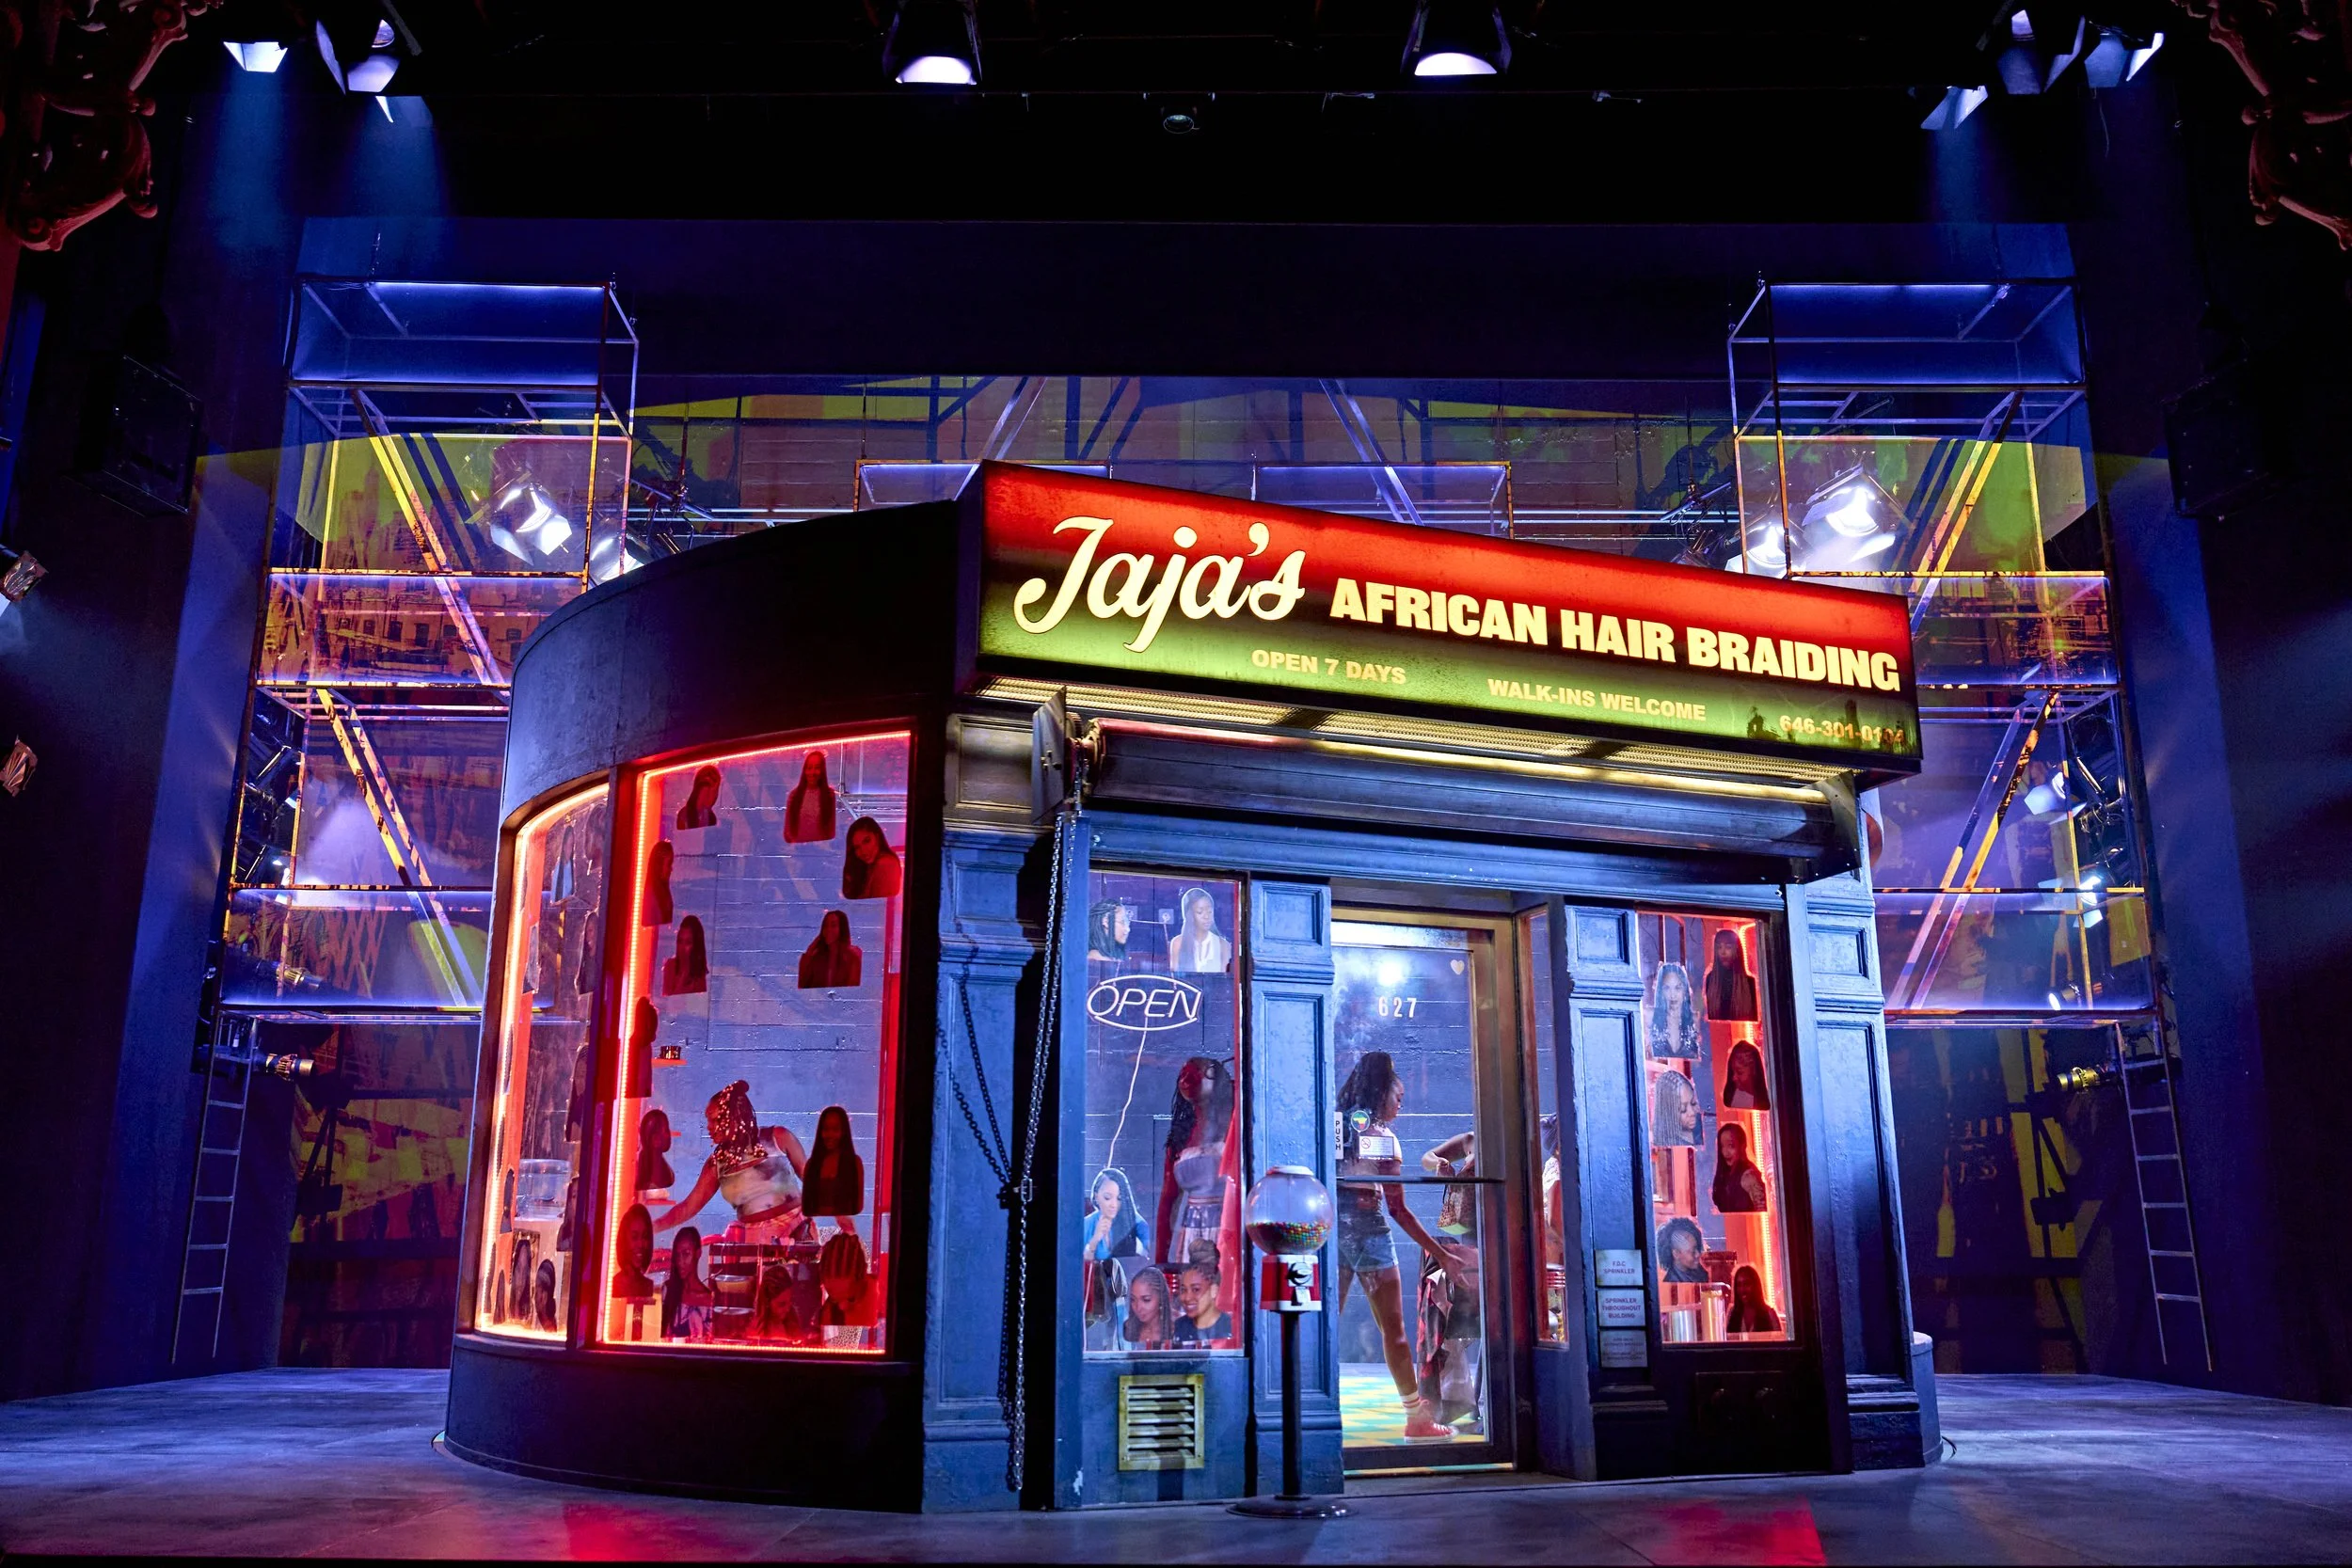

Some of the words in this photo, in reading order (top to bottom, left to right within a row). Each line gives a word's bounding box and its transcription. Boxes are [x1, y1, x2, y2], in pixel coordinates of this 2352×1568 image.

[1013, 515, 1307, 653] Jaja's
[1330, 578, 1548, 646] AFRICAN
[1560, 609, 1677, 663] HAIR
[1687, 626, 1900, 692] BRAIDING
[1251, 648, 1319, 674] OPEN
[1324, 658, 1339, 675] 7
[1345, 660, 1407, 685] DAYS
[1487, 678, 1596, 708] WALK-INS
[1599, 691, 1707, 721] WELCOME
[1087, 985, 1201, 1019] OPEN
[1378, 997, 1417, 1018] 627
